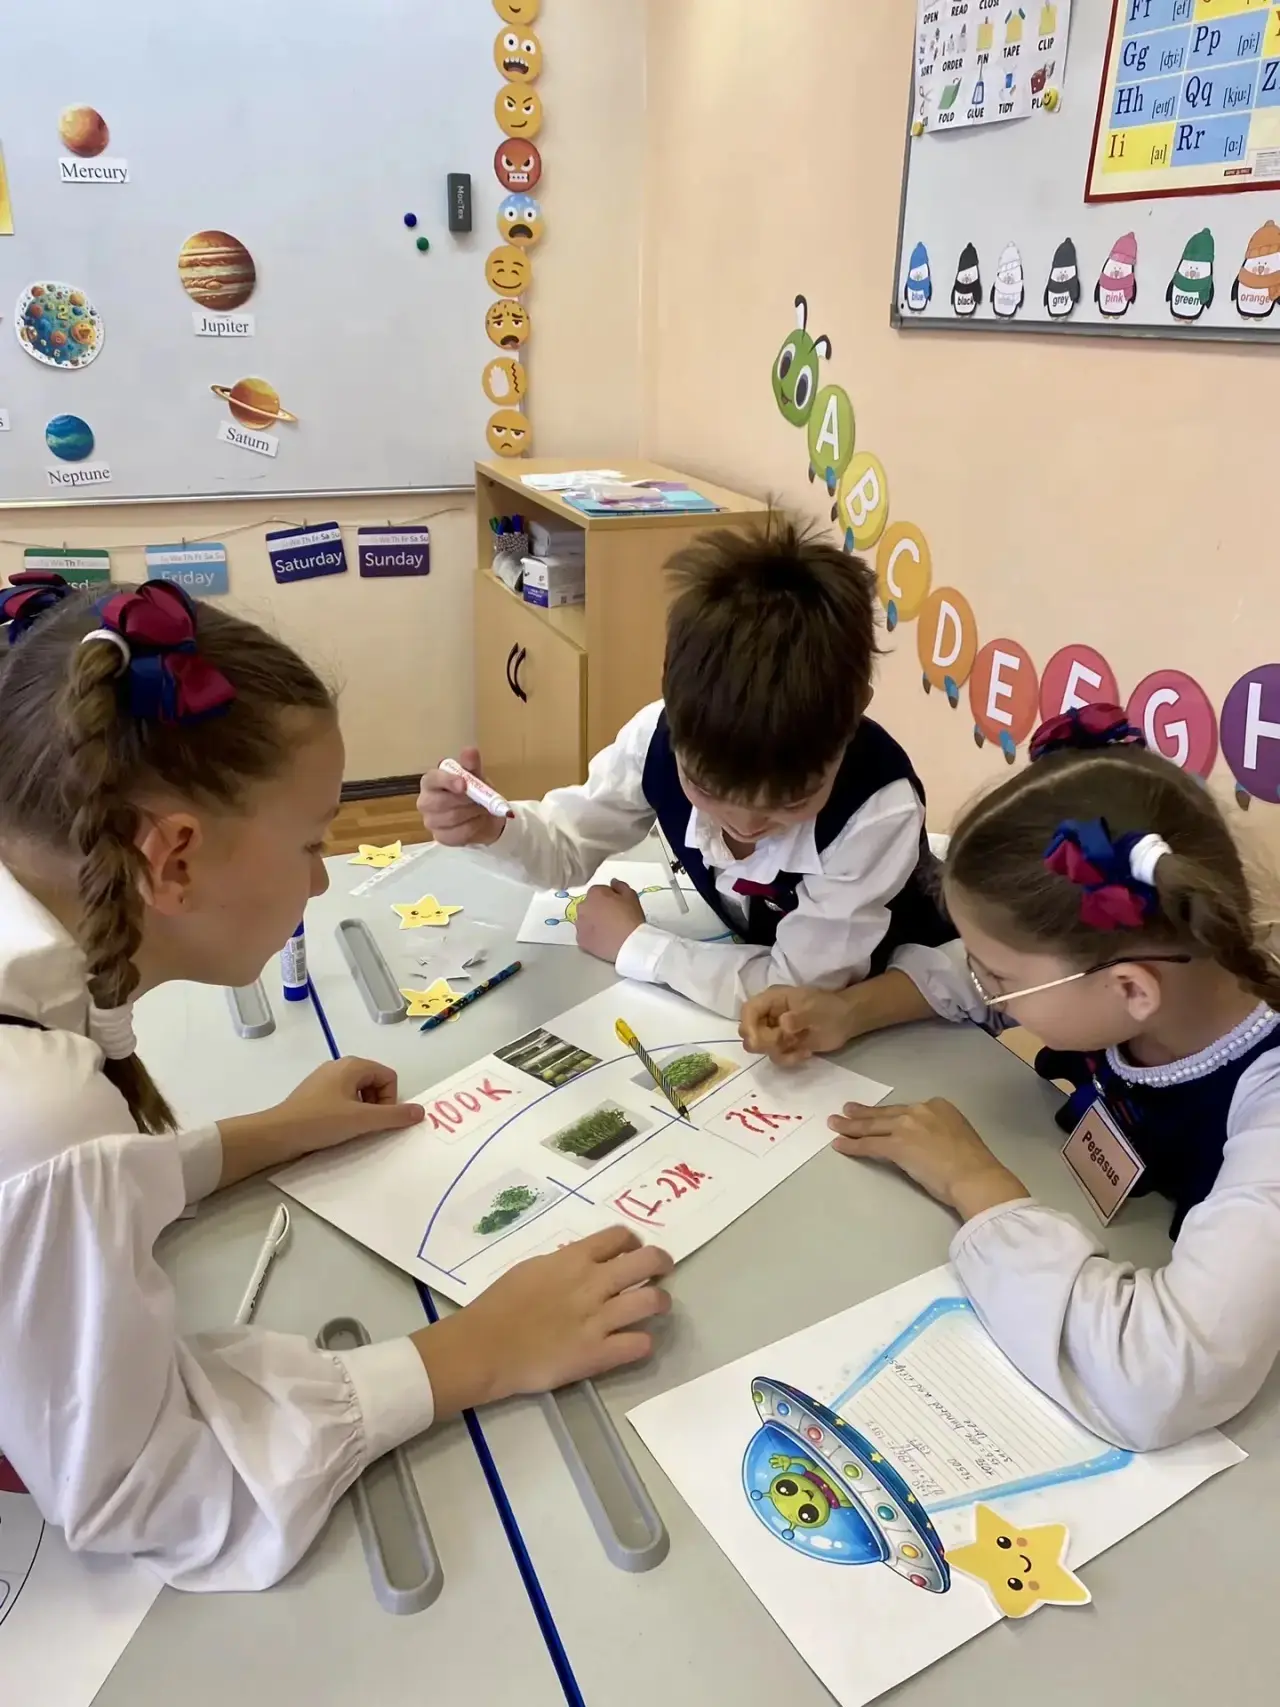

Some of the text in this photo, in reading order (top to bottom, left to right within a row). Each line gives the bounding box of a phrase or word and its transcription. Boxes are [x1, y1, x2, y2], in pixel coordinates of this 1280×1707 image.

[924, 11, 939, 24] OPEN
[951, 4, 968, 16] READ
[1038, 37, 1054, 51] CLIP
[1193, 25, 1221, 56] Pp
[977, 53, 989, 64] PIN
[1003, 45, 1020, 58] TAPE
[1123, 41, 1149, 71] Gg
[942, 58, 963, 72] ORDER
[1185, 76, 1213, 108] Qq
[1031, 99, 1044, 109] PLA
[1115, 86, 1144, 114] Hh
[967, 108, 984, 119] GLUE
[999, 102, 1014, 114] TIDY
[938, 112, 955, 123] FOLD
[1176, 124, 1205, 151] Rr
[1108, 134, 1125, 158] Ii
[61, 162, 128, 182] Mercury
[957, 294, 974, 305] black
[1052, 295, 1069, 307] grey
[1105, 293, 1123, 305] pink
[1174, 293, 1199, 306] green
[1240, 293, 1271, 305] orange
[201, 318, 249, 335] Jupiter
[225, 427, 270, 452] Saturn
[48, 466, 110, 486] Neptune
[275, 552, 342, 573] Saturday
[365, 552, 424, 568] Sunday
[816, 395, 840, 460] A
[845, 468, 880, 526] B
[886, 538, 920, 598] C
[932, 600, 962, 667] D
[986, 650, 1020, 726] E
[1143, 688, 1189, 766] G
[1082, 1130, 1120, 1186] Pegasus
[927, 1400, 964, 1430] hundred
